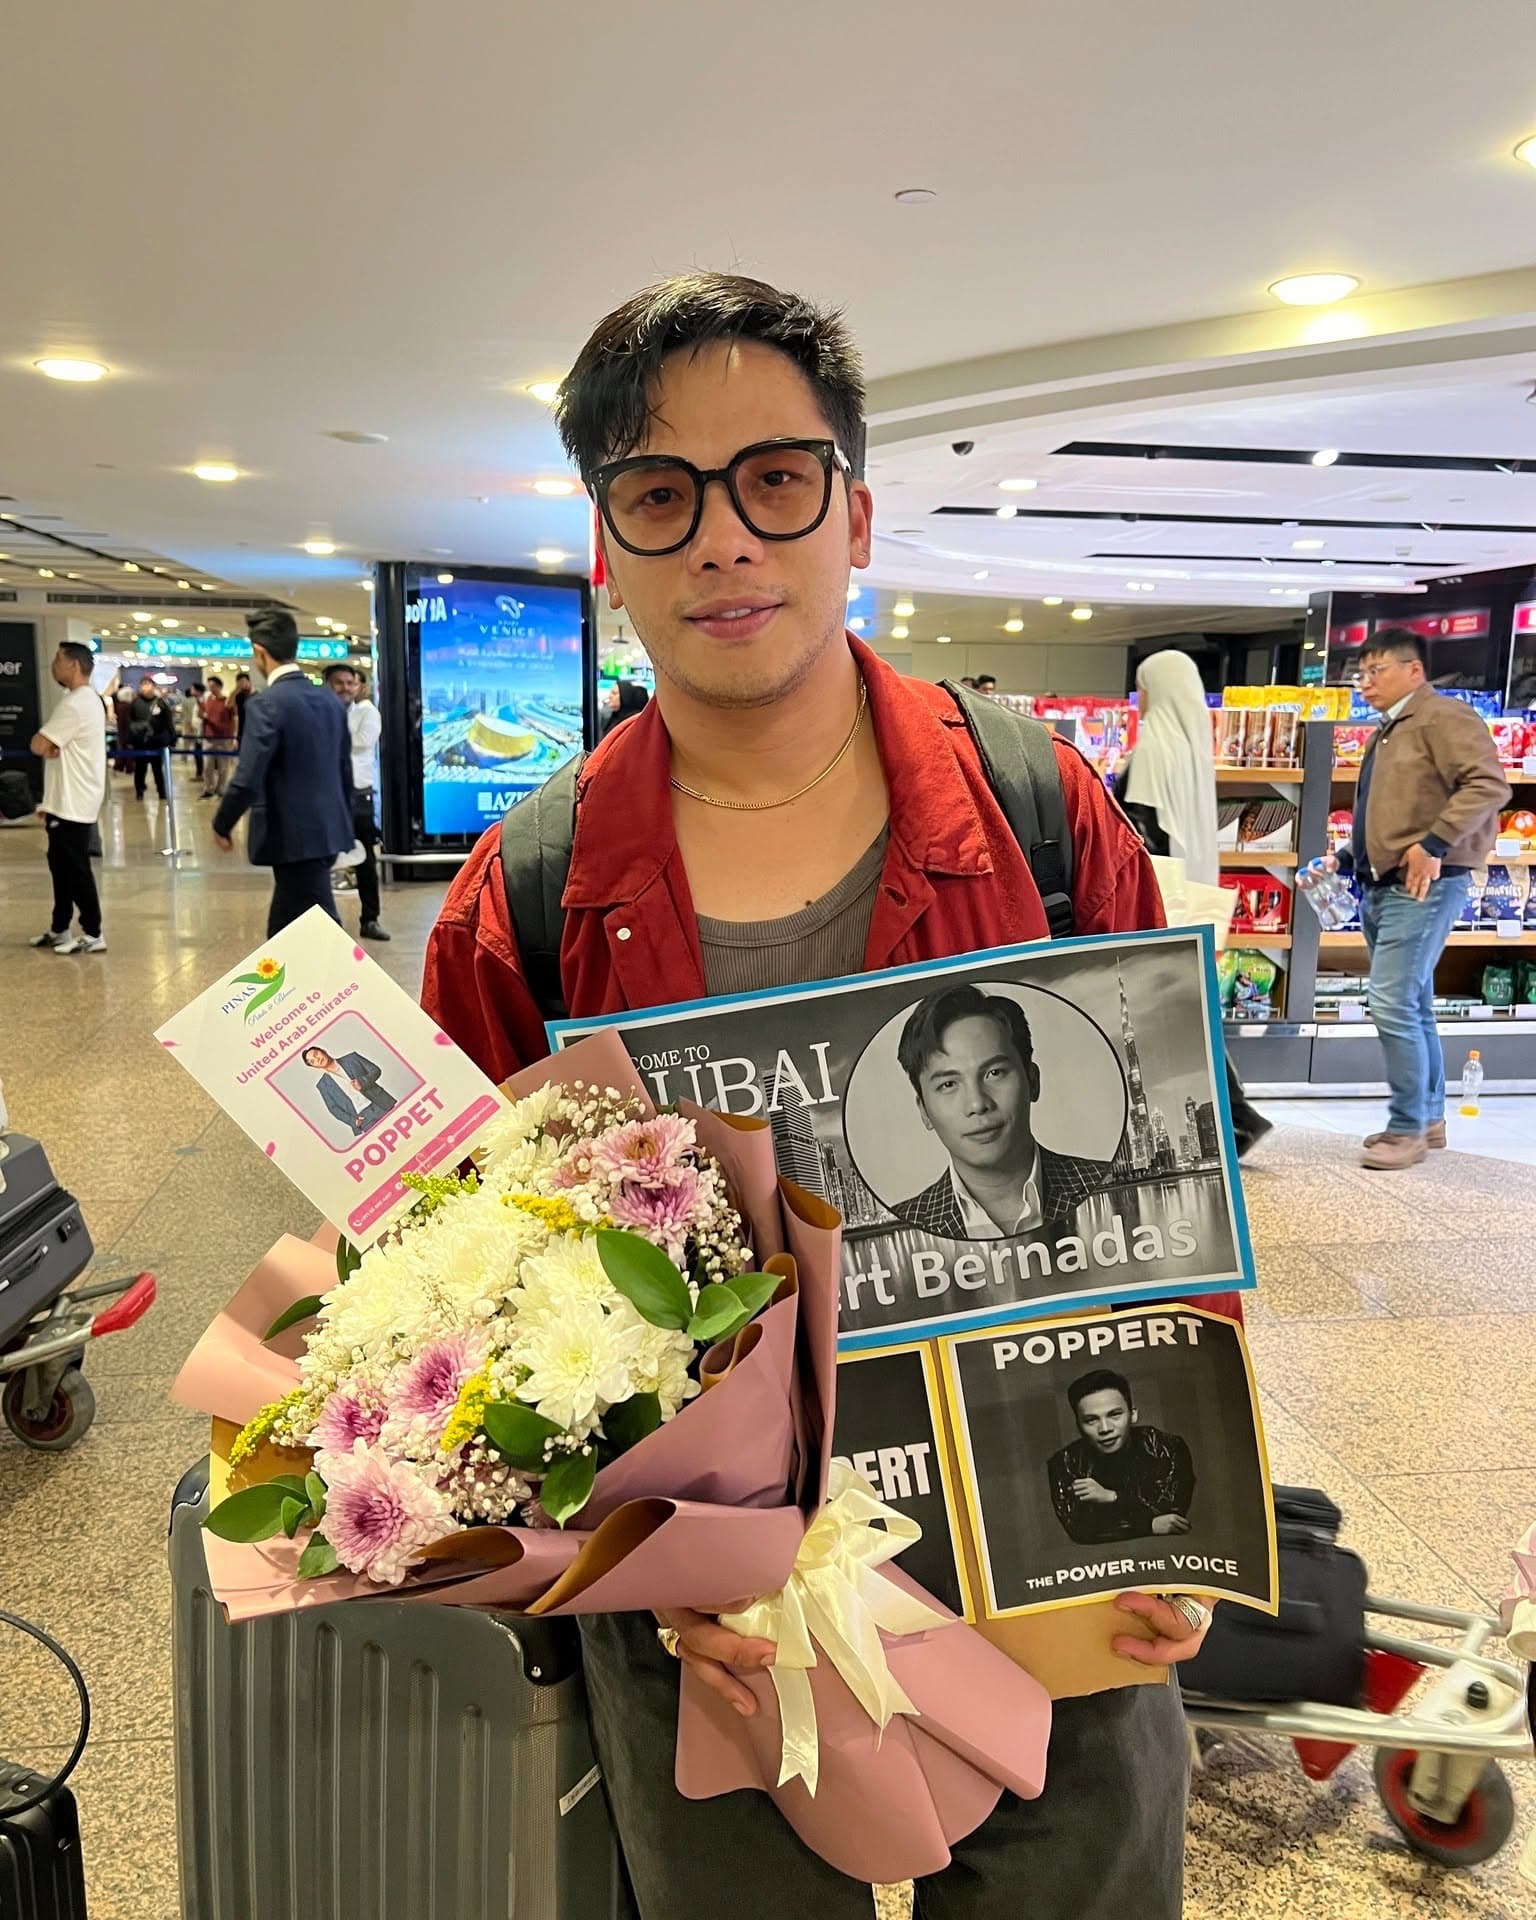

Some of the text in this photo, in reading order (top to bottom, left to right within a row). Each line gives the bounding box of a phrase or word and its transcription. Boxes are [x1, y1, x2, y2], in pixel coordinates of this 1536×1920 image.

[480, 624, 536, 637] VENICE
[221, 985, 257, 1014] PINAS
[250, 991, 321, 1049] Welcome to
[236, 982, 359, 1084] United Arab Emirates
[684, 1044, 710, 1062] TO
[648, 1041, 840, 1116] UBAI
[344, 1087, 444, 1183] POPPET
[838, 1214, 1198, 1311] rt Bernadas
[992, 1316, 1204, 1370] POPPERT
[832, 1441, 931, 1502] ERT
[1026, 1554, 1239, 1590] THE POWER THE VOICE
